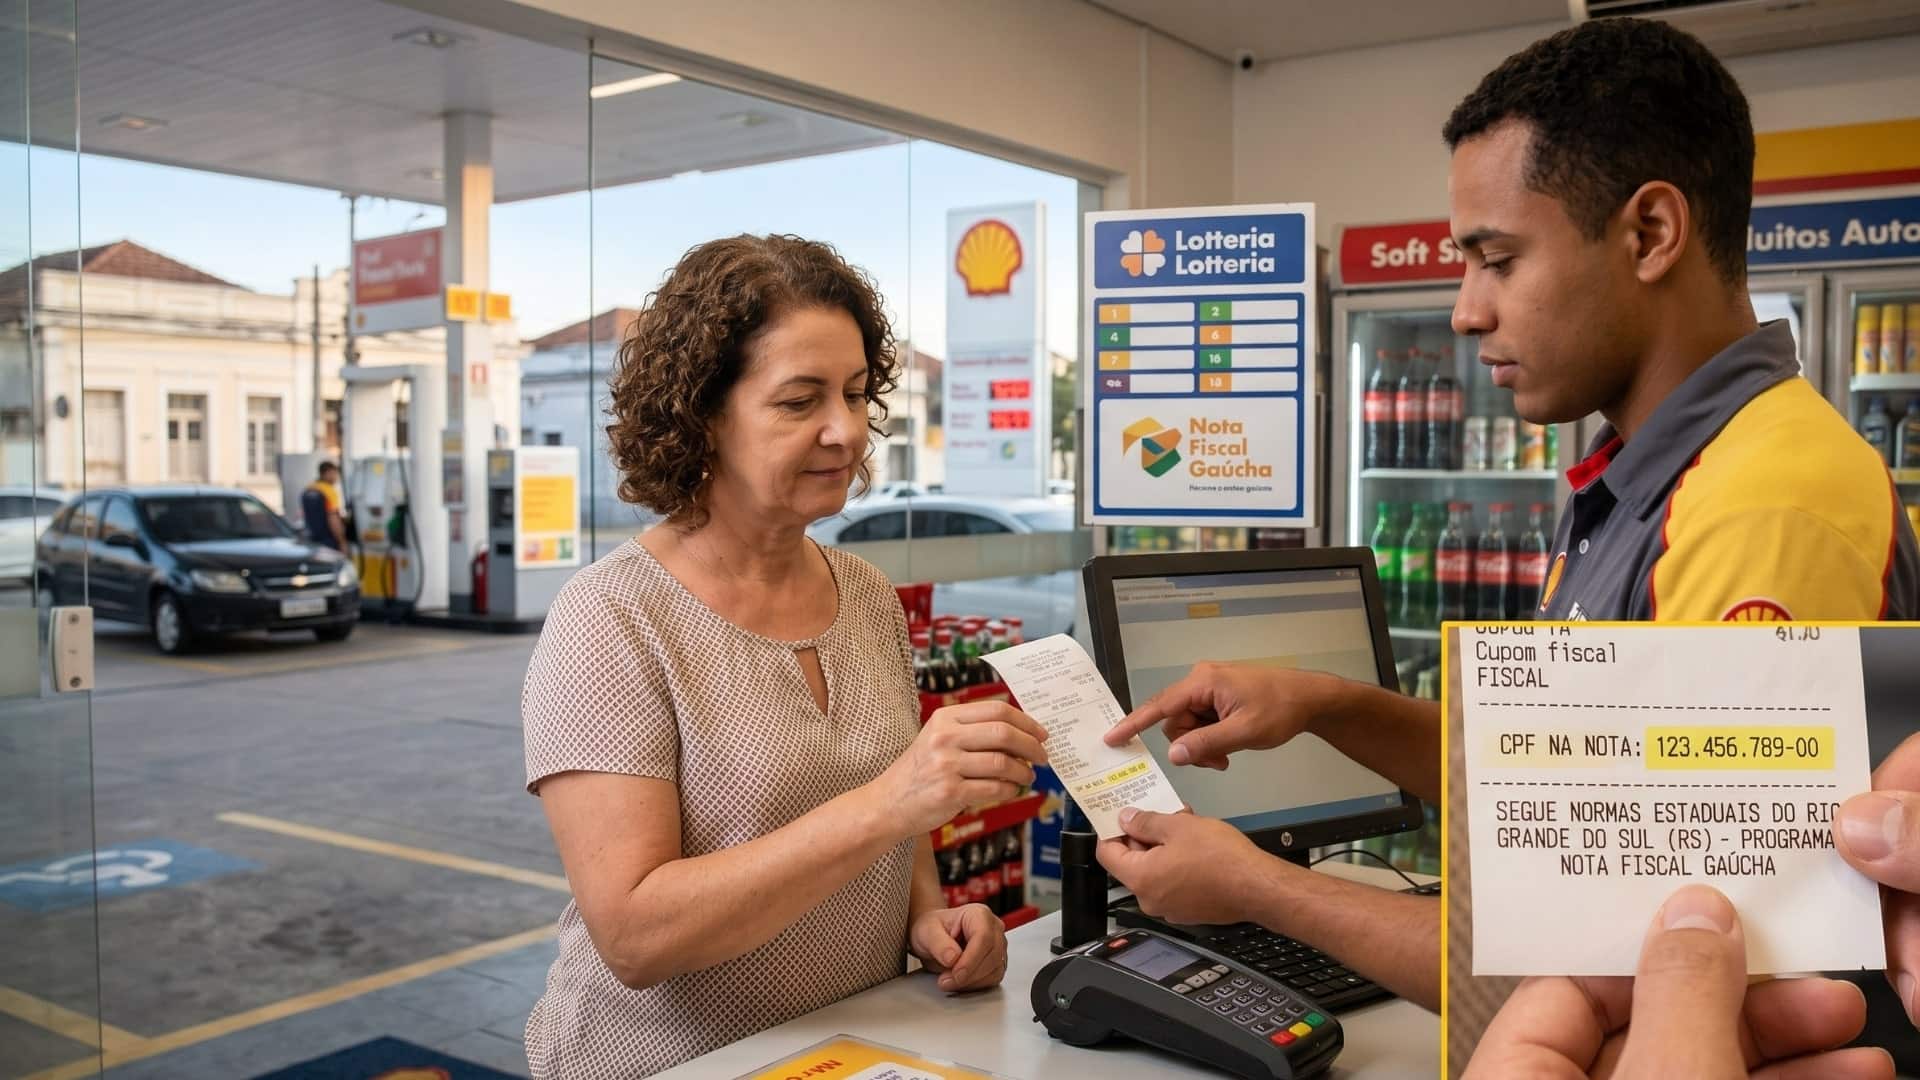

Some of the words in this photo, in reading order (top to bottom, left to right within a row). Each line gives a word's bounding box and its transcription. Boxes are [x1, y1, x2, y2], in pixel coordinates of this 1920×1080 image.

[1176, 226, 1275, 251] Lotteria
[1176, 251, 1275, 275] Lotteria
[1371, 237, 1430, 268] Soft
[1212, 306, 1220, 317] 2
[1110, 332, 1119, 342] 4
[1211, 330, 1220, 340] 6
[1189, 417, 1243, 434] Nota
[1189, 438, 1248, 456] Fiscal
[1189, 458, 1272, 478] Gaúcha
[1475, 640, 1537, 664] Cupom
[1548, 640, 1616, 664] fiscal
[1477, 666, 1549, 688] FISCAL
[1500, 734, 1536, 755] CPF
[1548, 734, 1573, 756] NA
[1584, 735, 1641, 757] NOTA:
[1656, 736, 1819, 758] 123.456.789-00
[1496, 800, 1557, 822] SEGUE
[1569, 801, 1641, 823] NORMAS
[1654, 802, 1760, 824] ESTADUAIS
[1771, 802, 1796, 823] DO
[1497, 827, 1571, 849] GRANDE
[1582, 828, 1607, 849] DO
[1618, 828, 1655, 850] SUL
[1668, 828, 1713, 852] (RS)
[1740, 828, 1835, 850] PROGRAMA
[1560, 854, 1609, 876] NOTA
[1621, 855, 1693, 876] FISCAL
[1704, 851, 1777, 876] GAÚCHA
